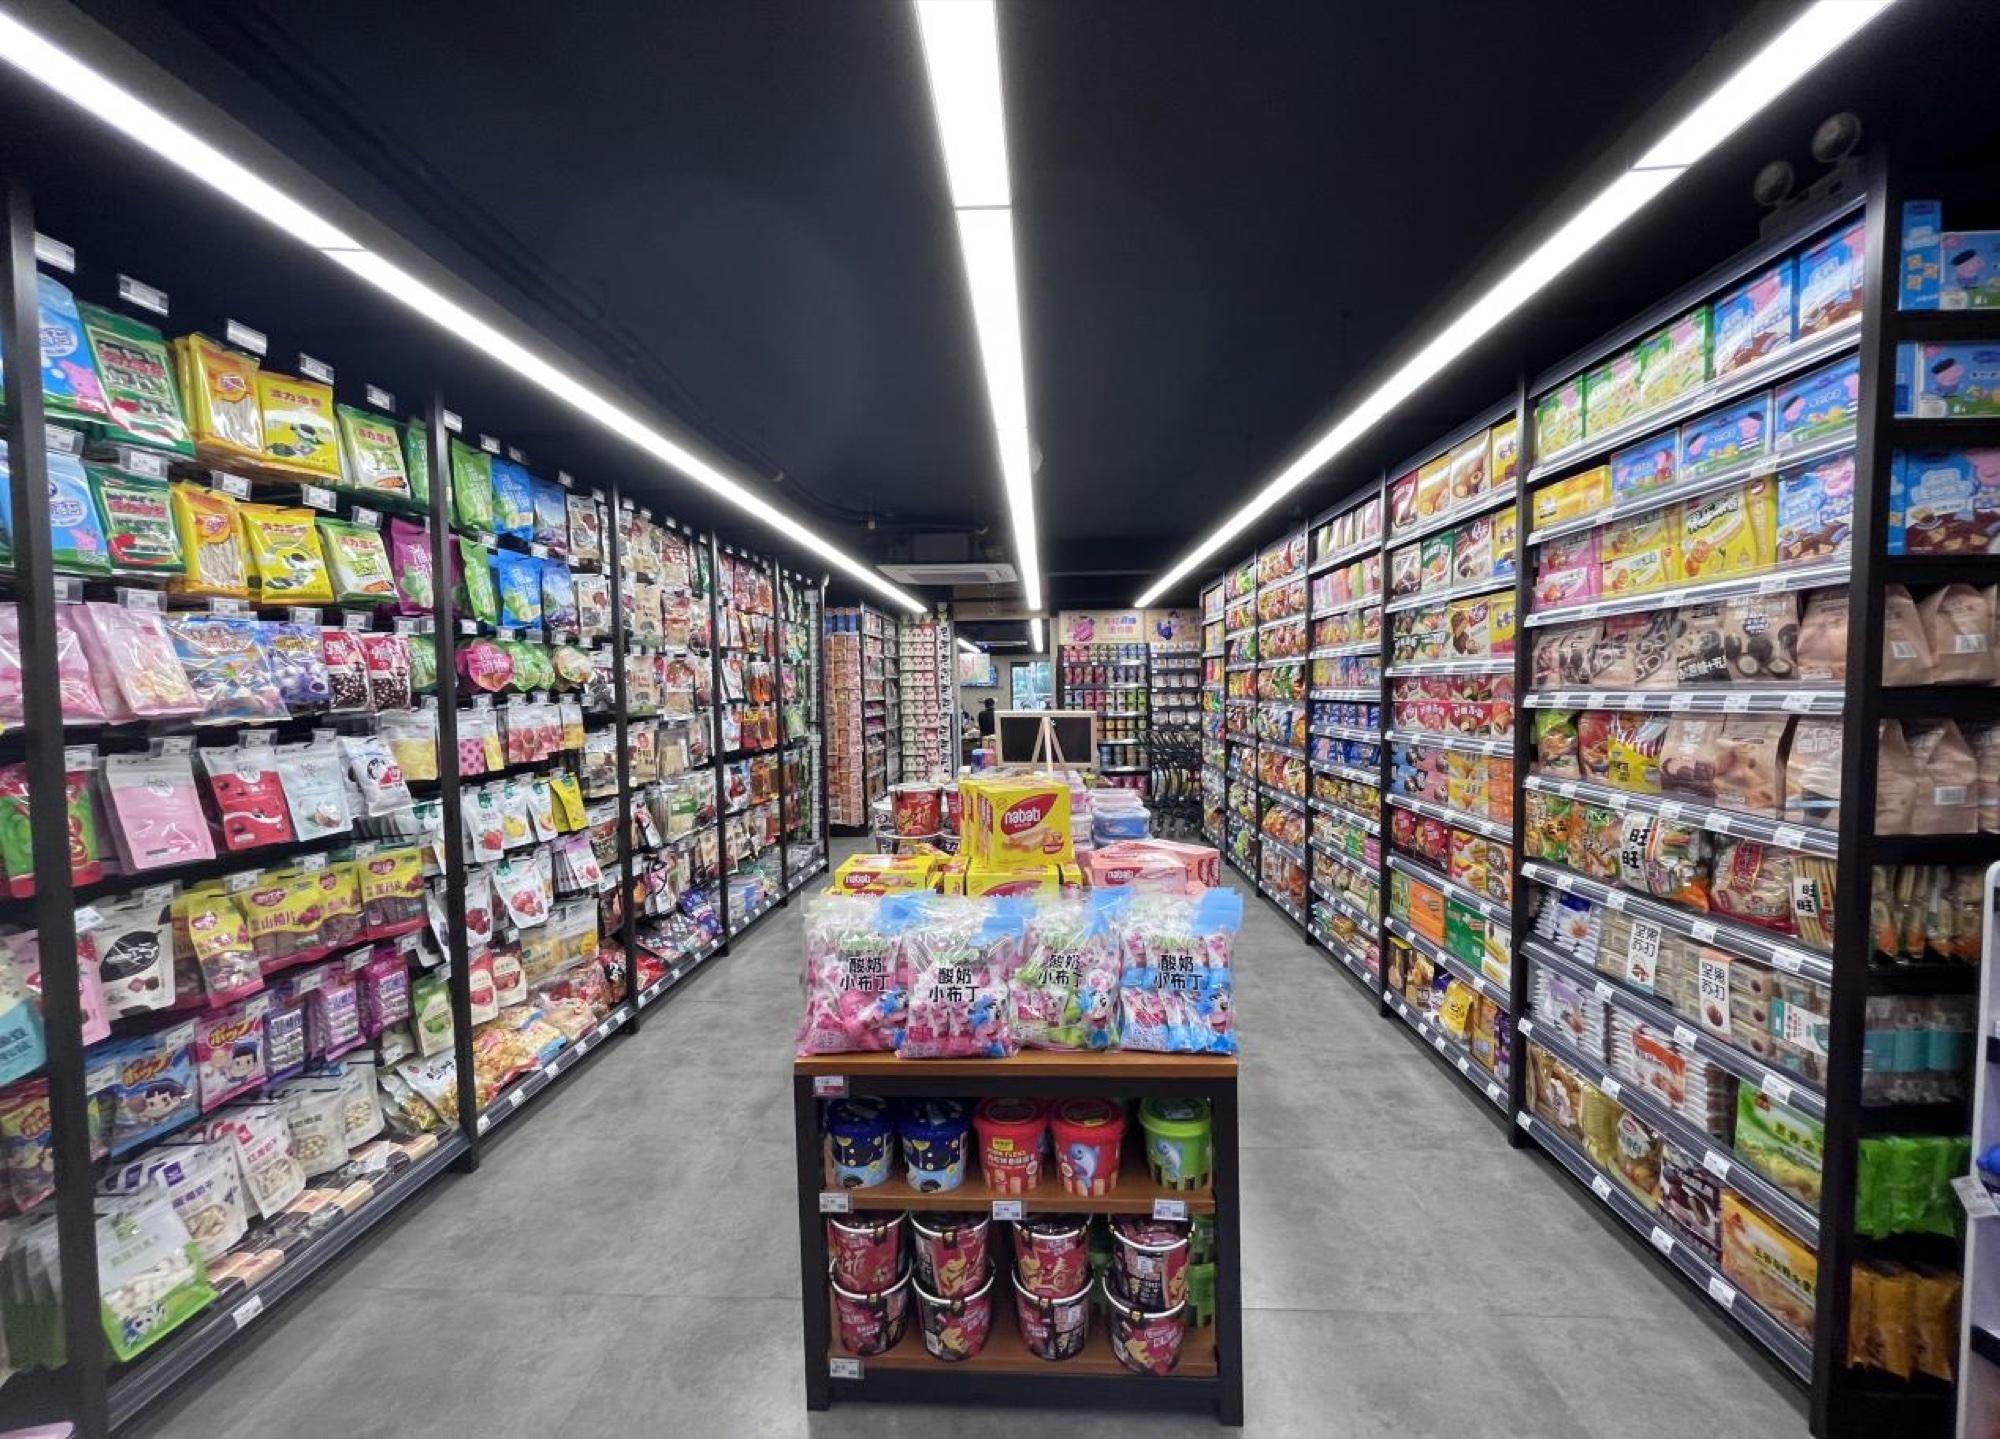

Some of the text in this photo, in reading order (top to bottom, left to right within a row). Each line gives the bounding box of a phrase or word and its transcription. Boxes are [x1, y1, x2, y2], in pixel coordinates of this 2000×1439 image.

[1004, 806, 1041, 824] nabati
[849, 957, 882, 973] 酸奶
[1049, 954, 1080, 970] 酸奶
[1160, 954, 1194, 972] 酸奶
[839, 975, 890, 992] 小布丁
[938, 967, 972, 984] 酸奶
[1038, 970, 1083, 988] 小布丁
[1153, 973, 1203, 991] 小布丁
[929, 986, 980, 1002] 小布丁
